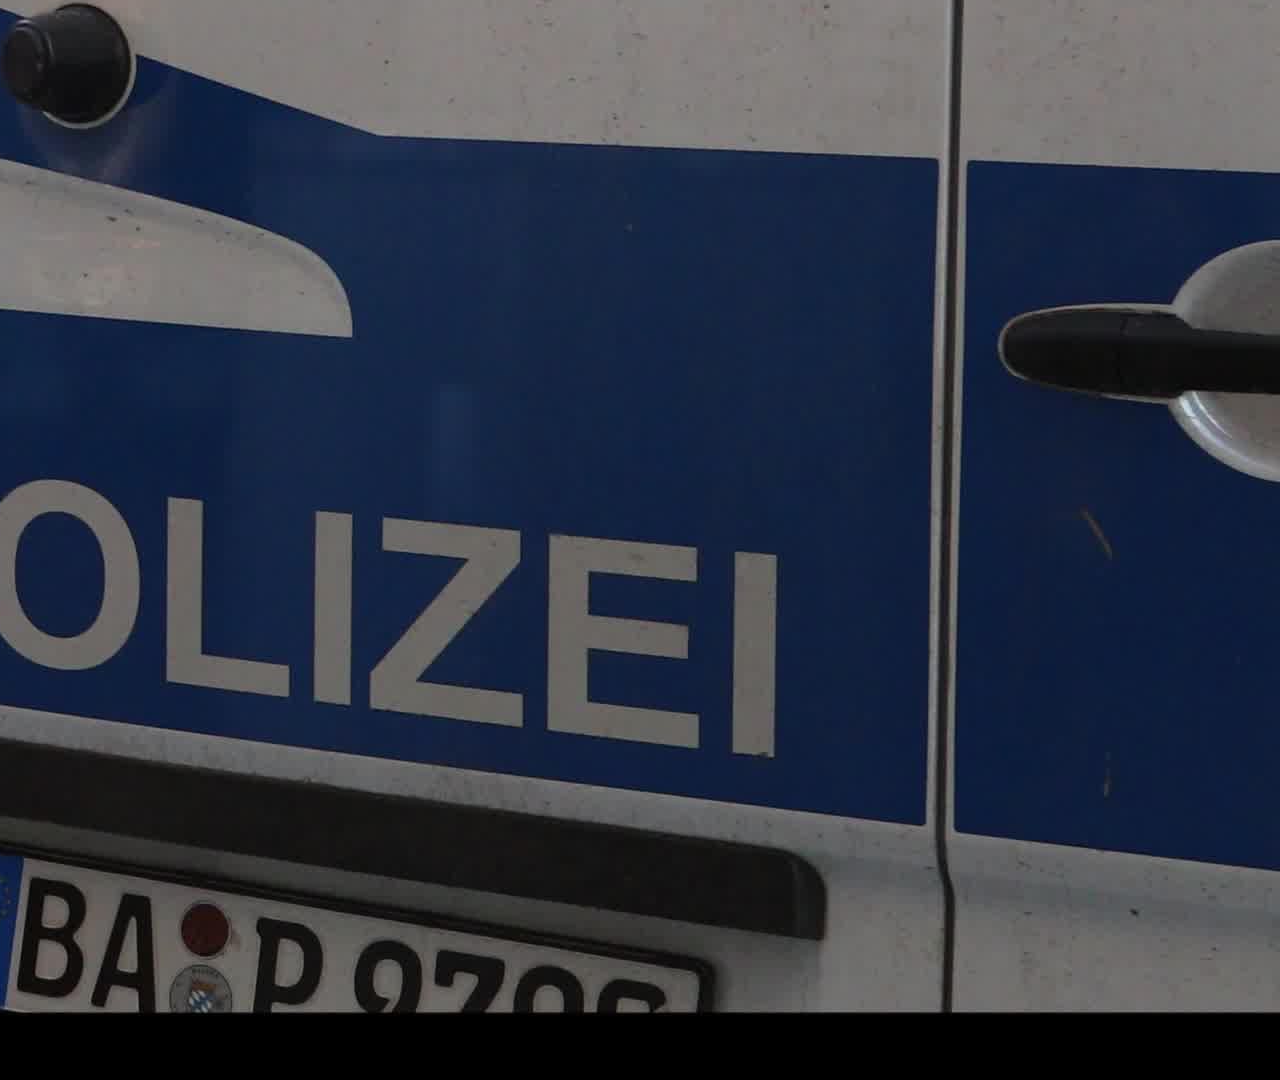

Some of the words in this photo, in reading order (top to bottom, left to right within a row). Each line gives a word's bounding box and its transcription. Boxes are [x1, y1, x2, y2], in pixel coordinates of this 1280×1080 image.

[16, 877, 156, 1013] BA
[252, 916, 323, 1013] P
[353, 939, 667, 1013] 97
